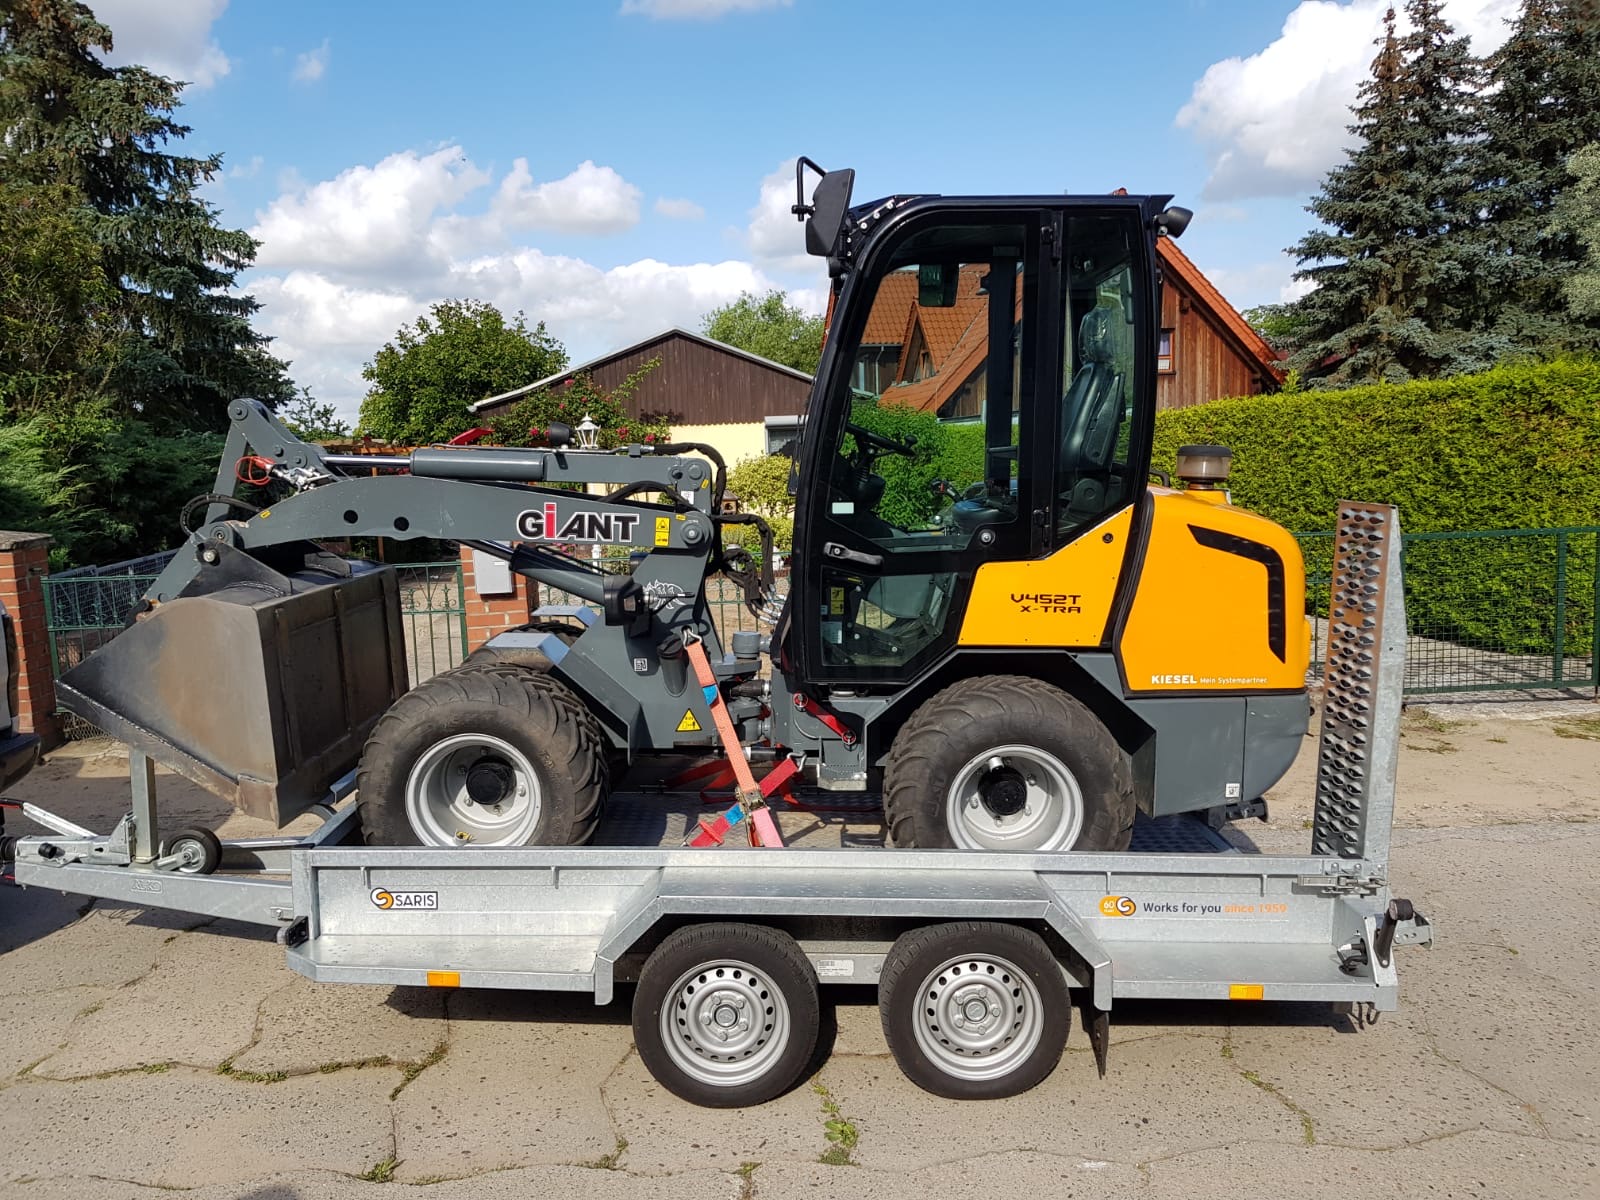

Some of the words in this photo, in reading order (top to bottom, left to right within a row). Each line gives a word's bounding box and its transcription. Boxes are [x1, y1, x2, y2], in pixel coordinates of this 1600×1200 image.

[1010, 594, 1081, 604] V452T
[1020, 606, 1081, 614] X-TRA
[1151, 674, 1198, 684] KIESEL
[1218, 677, 1268, 686] Systempartner
[395, 894, 434, 907] SARIS
[1143, 902, 1178, 912] Works
[1182, 902, 1198, 912] for
[1201, 905, 1221, 915] you
[1224, 902, 1254, 912] since
[1259, 904, 1287, 912] 1959
